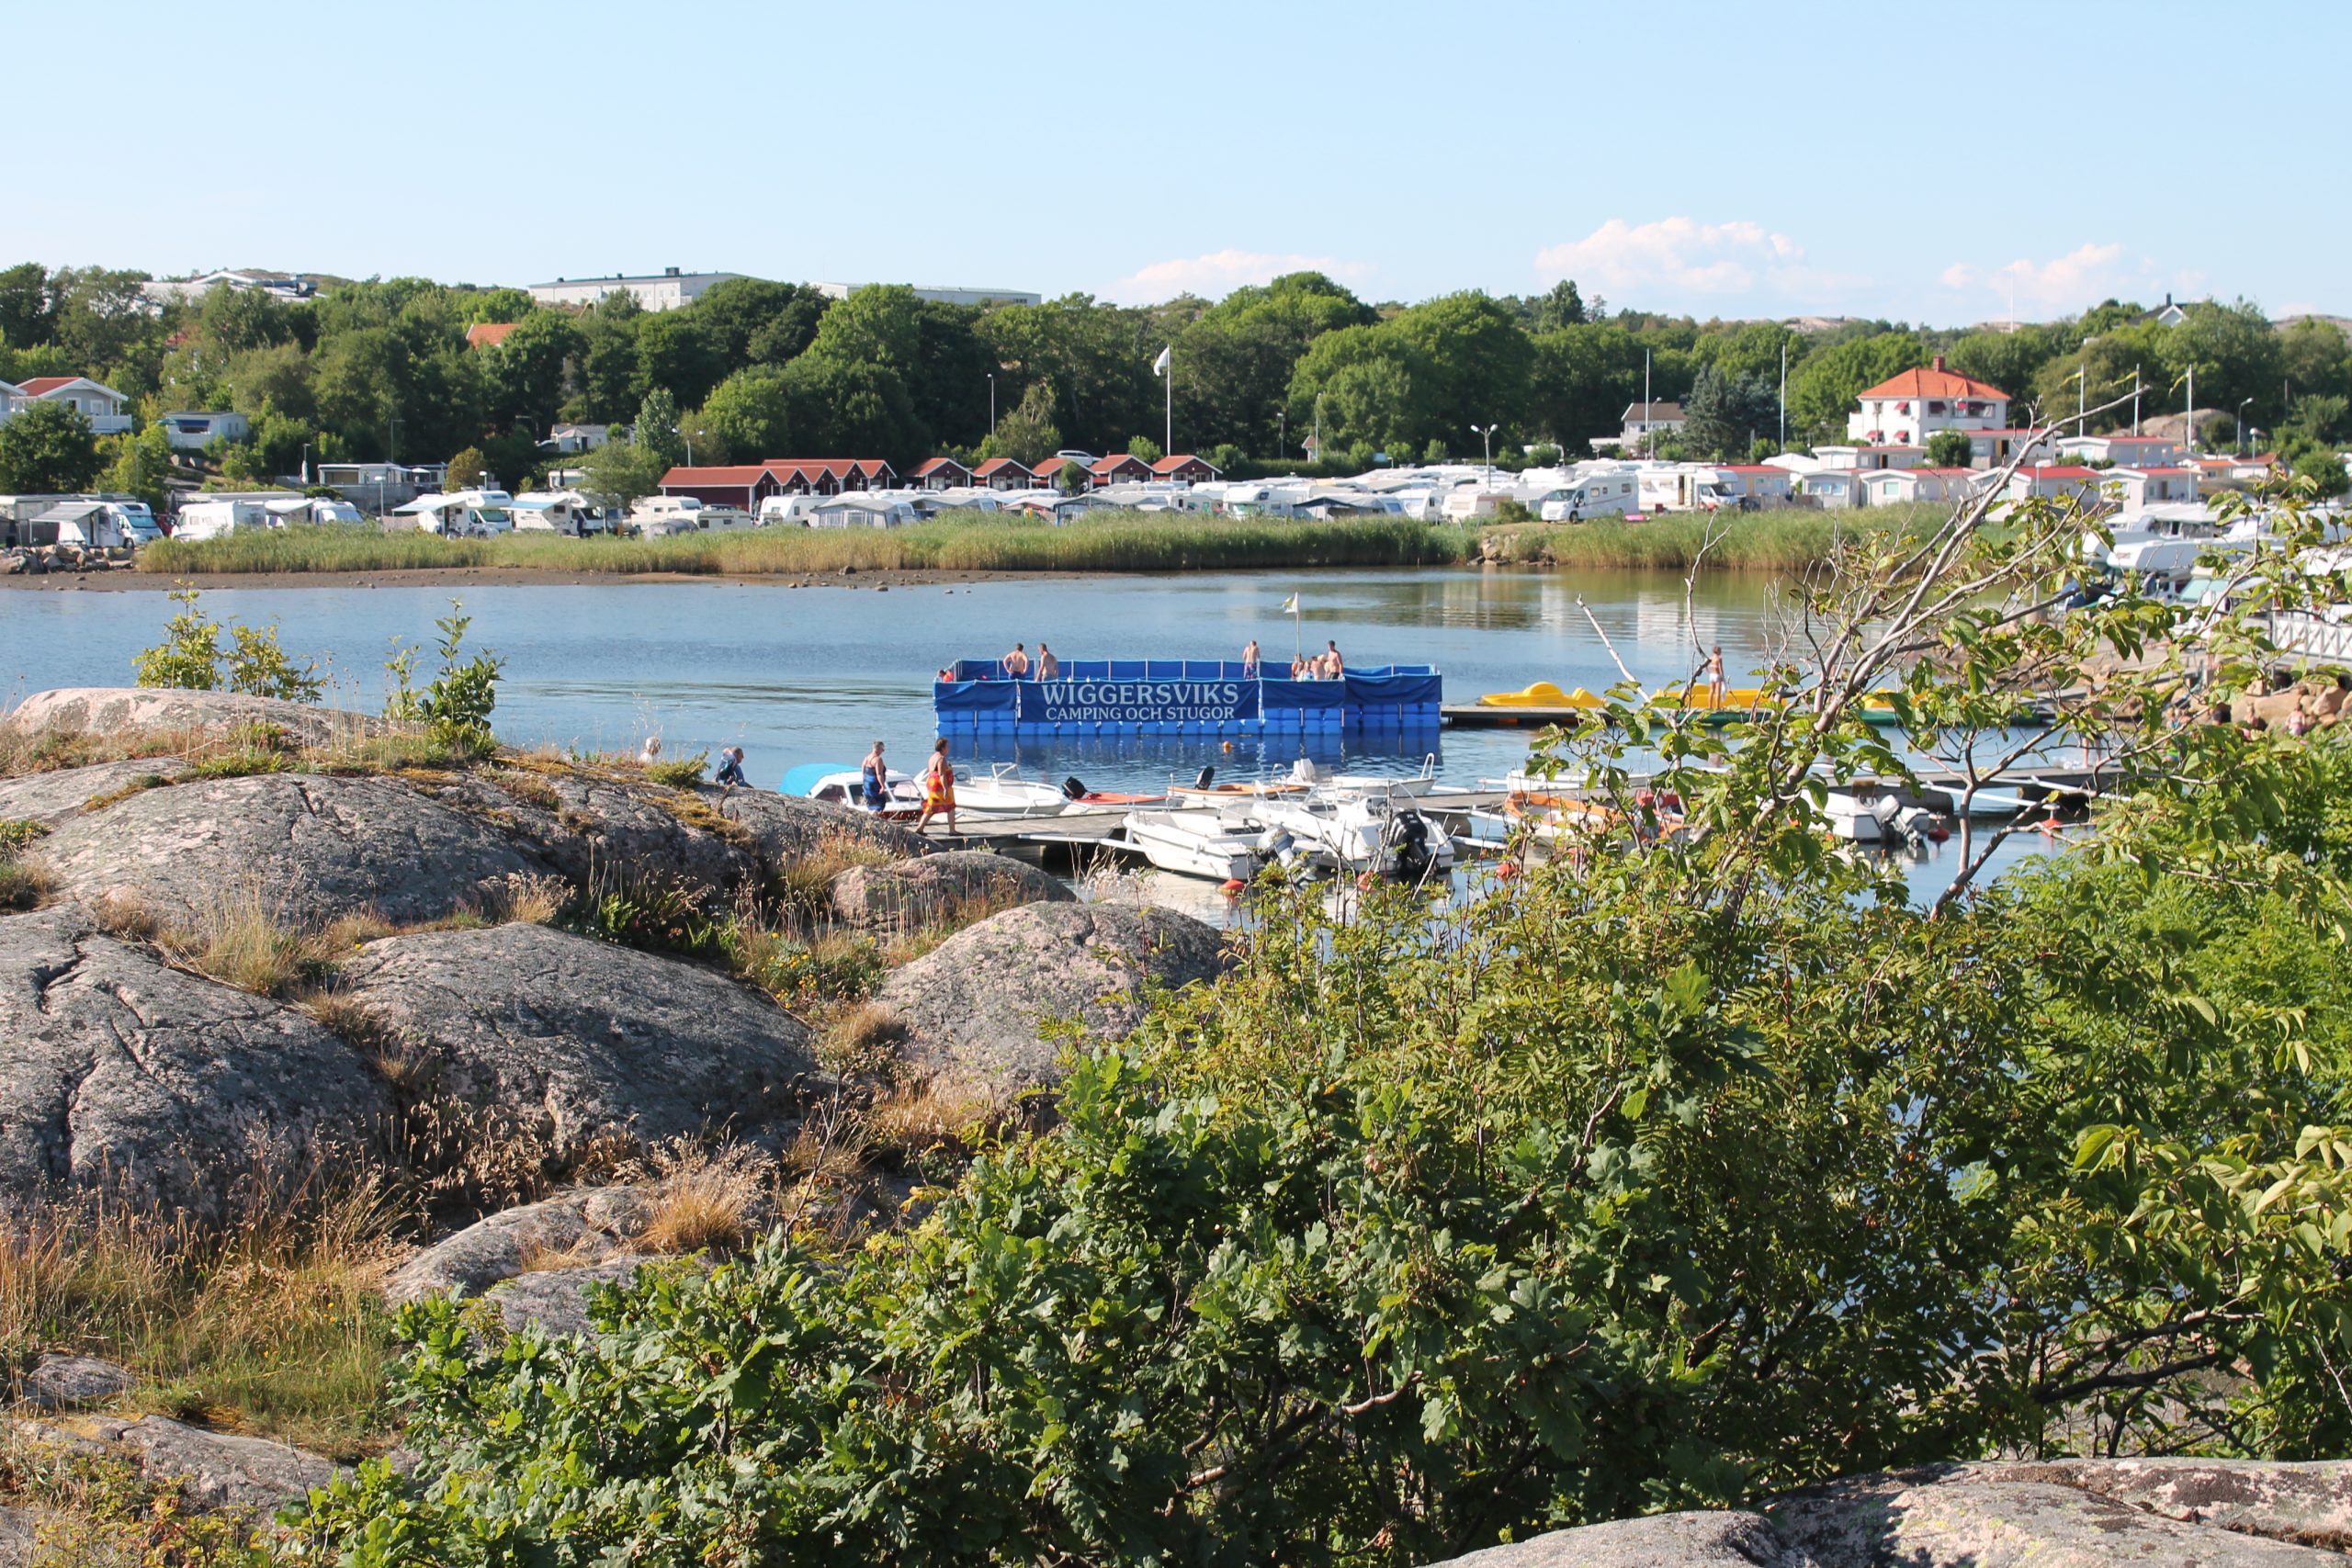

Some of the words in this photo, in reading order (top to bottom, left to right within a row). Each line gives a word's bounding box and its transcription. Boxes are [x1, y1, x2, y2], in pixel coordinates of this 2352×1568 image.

[1042, 683, 1238, 705] WIGGERSVIKS
[1046, 706, 1122, 721] CAMPING
[1125, 706, 1162, 721] OCH
[1166, 706, 1235, 720] STUGOR
